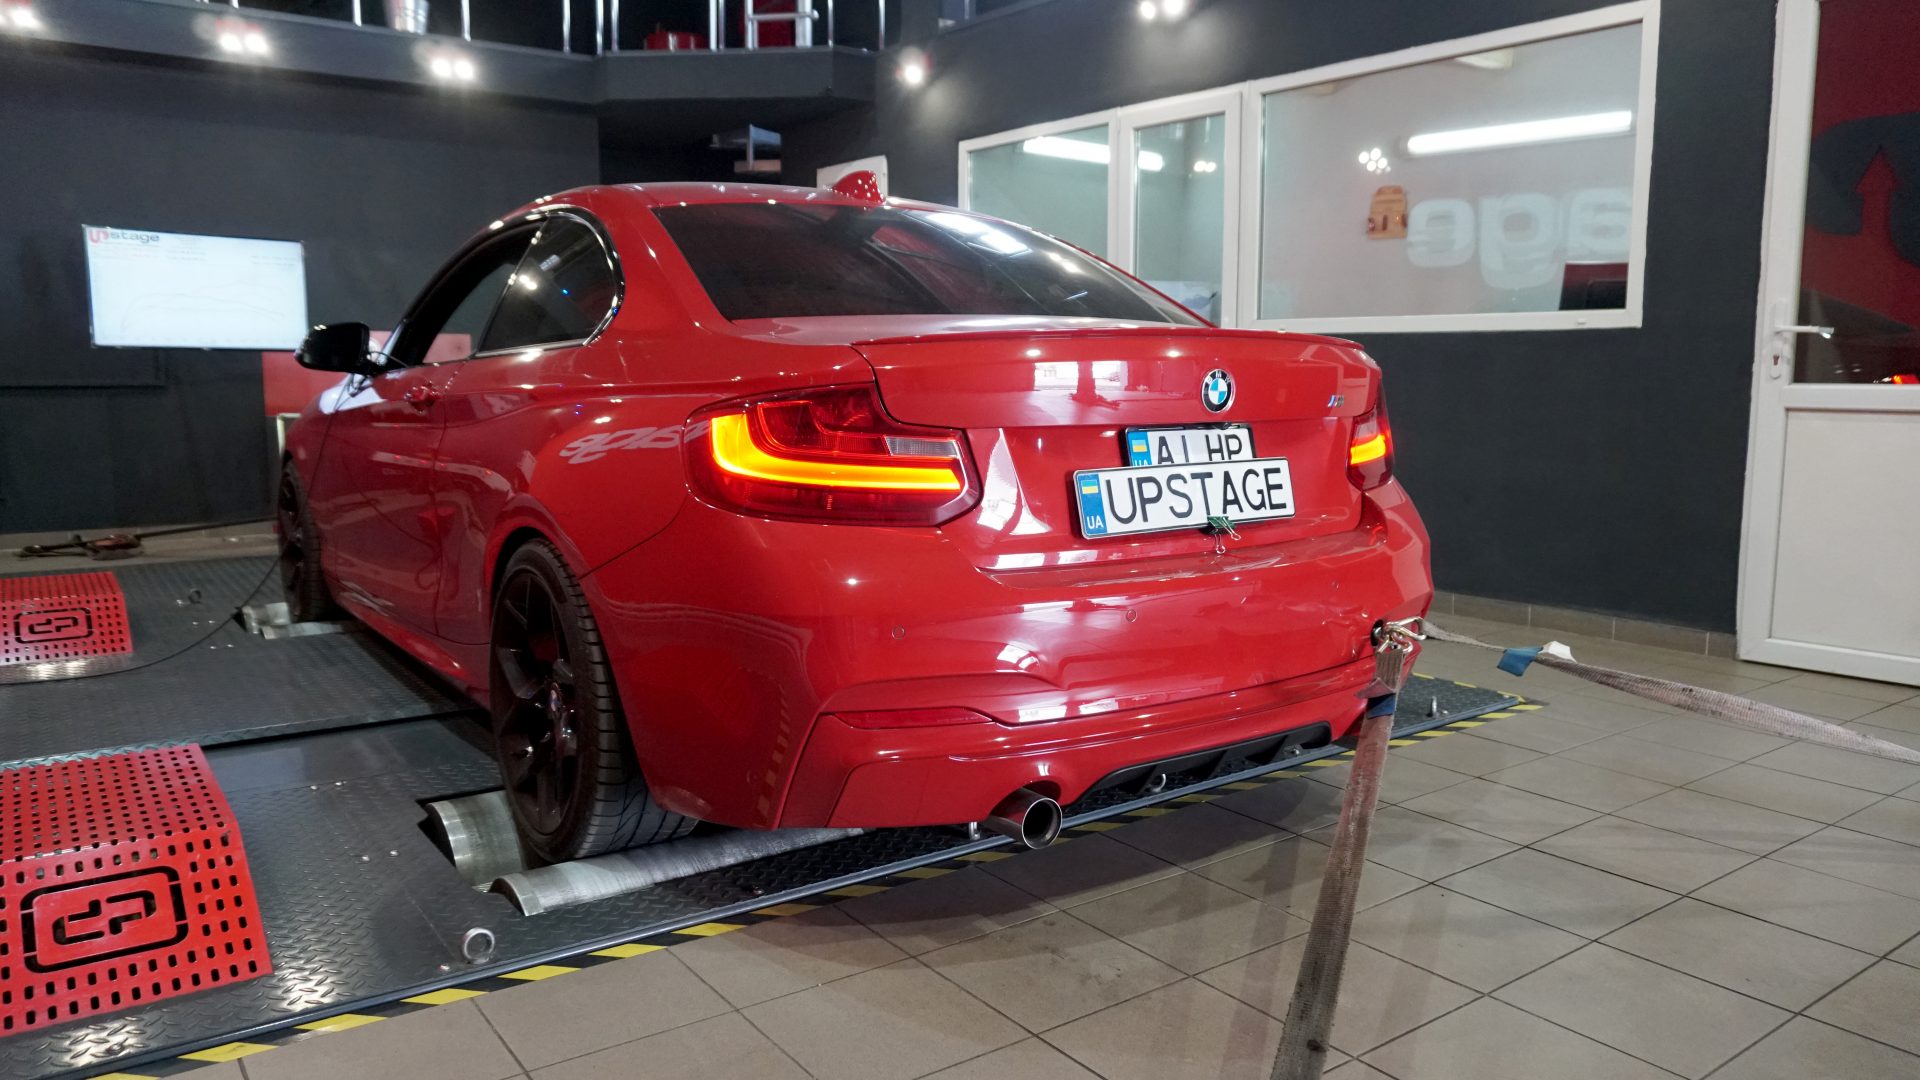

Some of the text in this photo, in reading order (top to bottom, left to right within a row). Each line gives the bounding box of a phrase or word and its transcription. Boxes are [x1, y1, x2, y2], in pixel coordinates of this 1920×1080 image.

[1206, 434, 1242, 461] HP
[1105, 467, 1287, 525] UPSTAGE
[1086, 516, 1104, 530] UA
